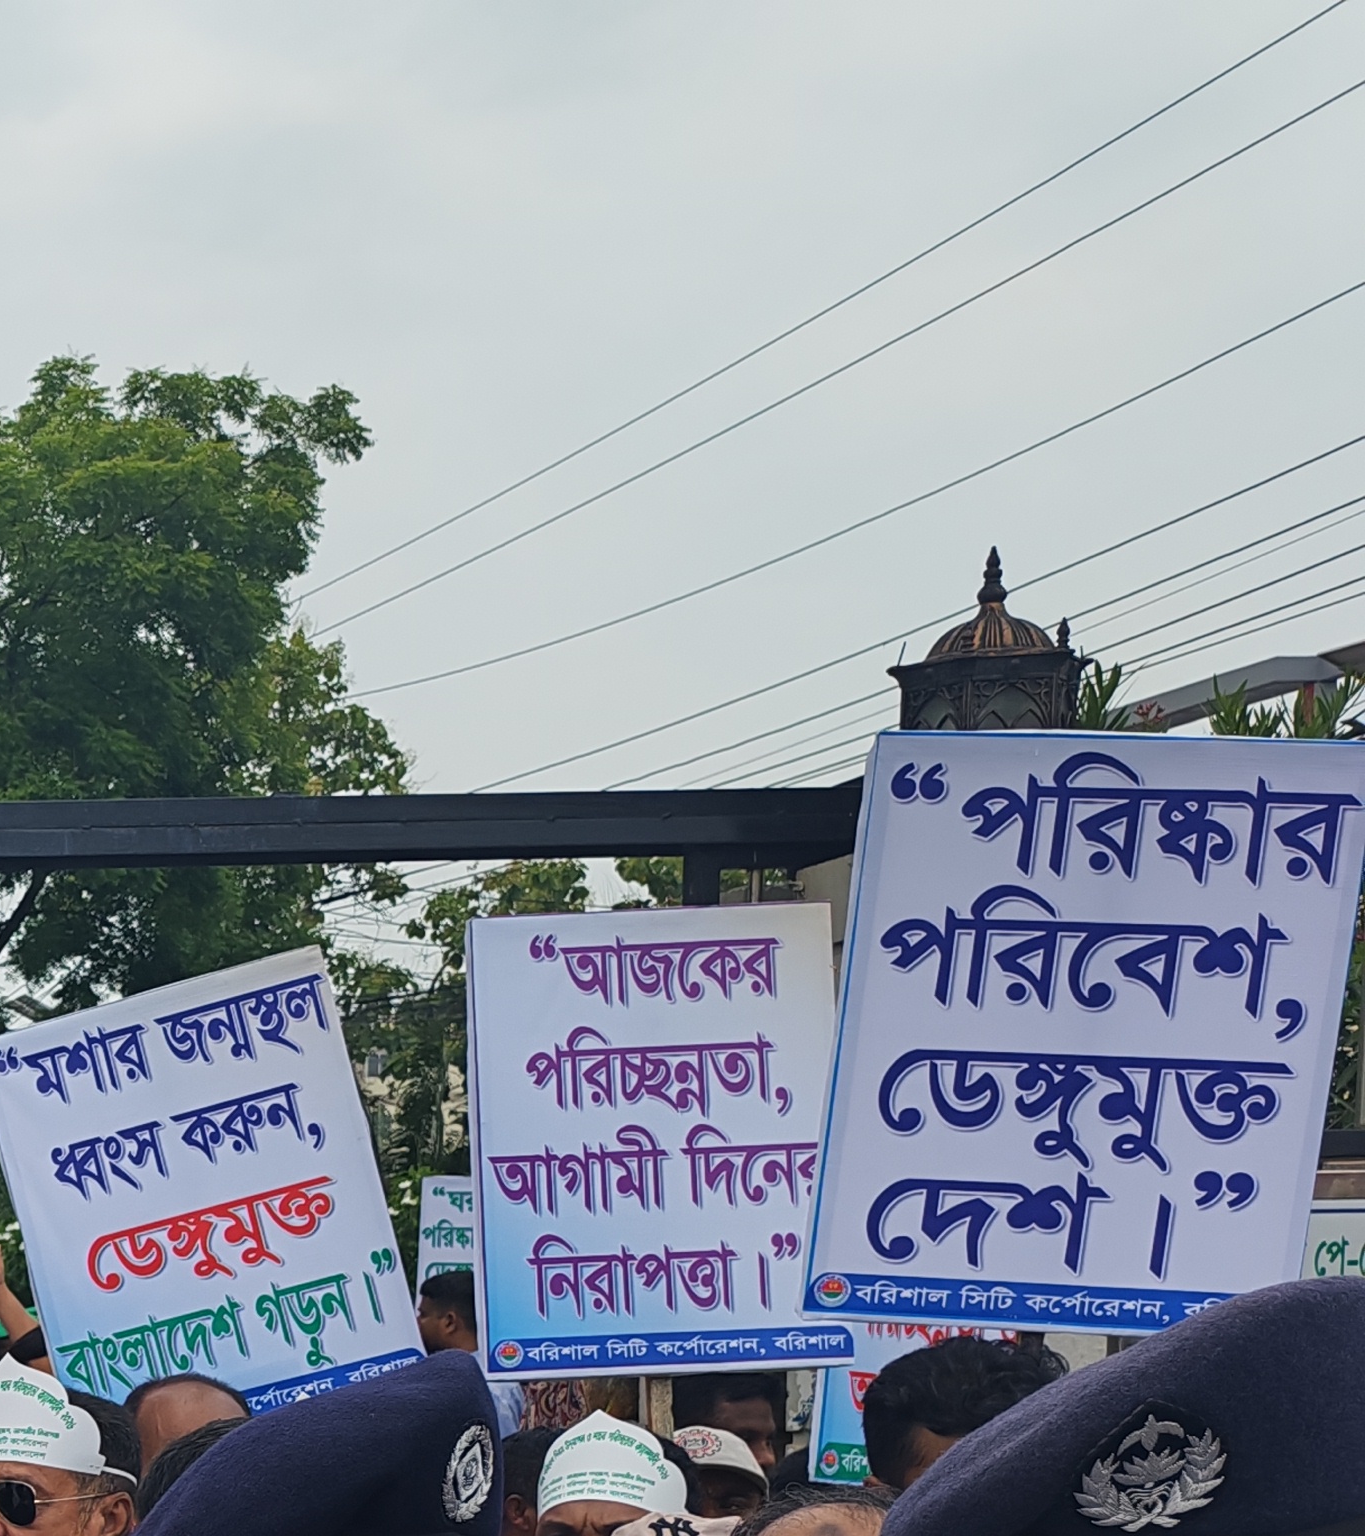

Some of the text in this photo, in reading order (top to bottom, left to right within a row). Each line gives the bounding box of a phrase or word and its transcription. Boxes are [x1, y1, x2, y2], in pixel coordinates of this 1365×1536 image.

[889, 751, 1364, 885] “পরিষ্কার
[530, 934, 782, 1006] “আজকের
[880, 885, 1305, 1041] পরিবেশ,
[156, 973, 331, 1065] জন্মস্থল
[526, 1024, 793, 1117] পরিচ্ছন্নতা,
[878, 1049, 1295, 1172] ডেঙ্গুমুক্ত
[52, 1083, 325, 1200] ধ্বংস করুন,
[488, 1124, 667, 1217] আগামী
[88, 1177, 336, 1291] ডেঙ্গুমুক্ত
[865, 1172, 1112, 1275] দেশ
[527, 1234, 739, 1319] নিরাপত্তা
[854, 1281, 951, 1308] বরিশাল
[959, 1286, 1016, 1310] সিটি
[1023, 1292, 1171, 1326] কর্পোরেশন,
[57, 1298, 250, 1397] বাংলাদেশ
[256, 1273, 355, 1369] গড়ুন
[526, 1336, 602, 1364] বরিশাল
[606, 1335, 649, 1361] সিটি
[654, 1332, 768, 1360] কর্পোরেশন,
[772, 1330, 848, 1357] বরিশাল
